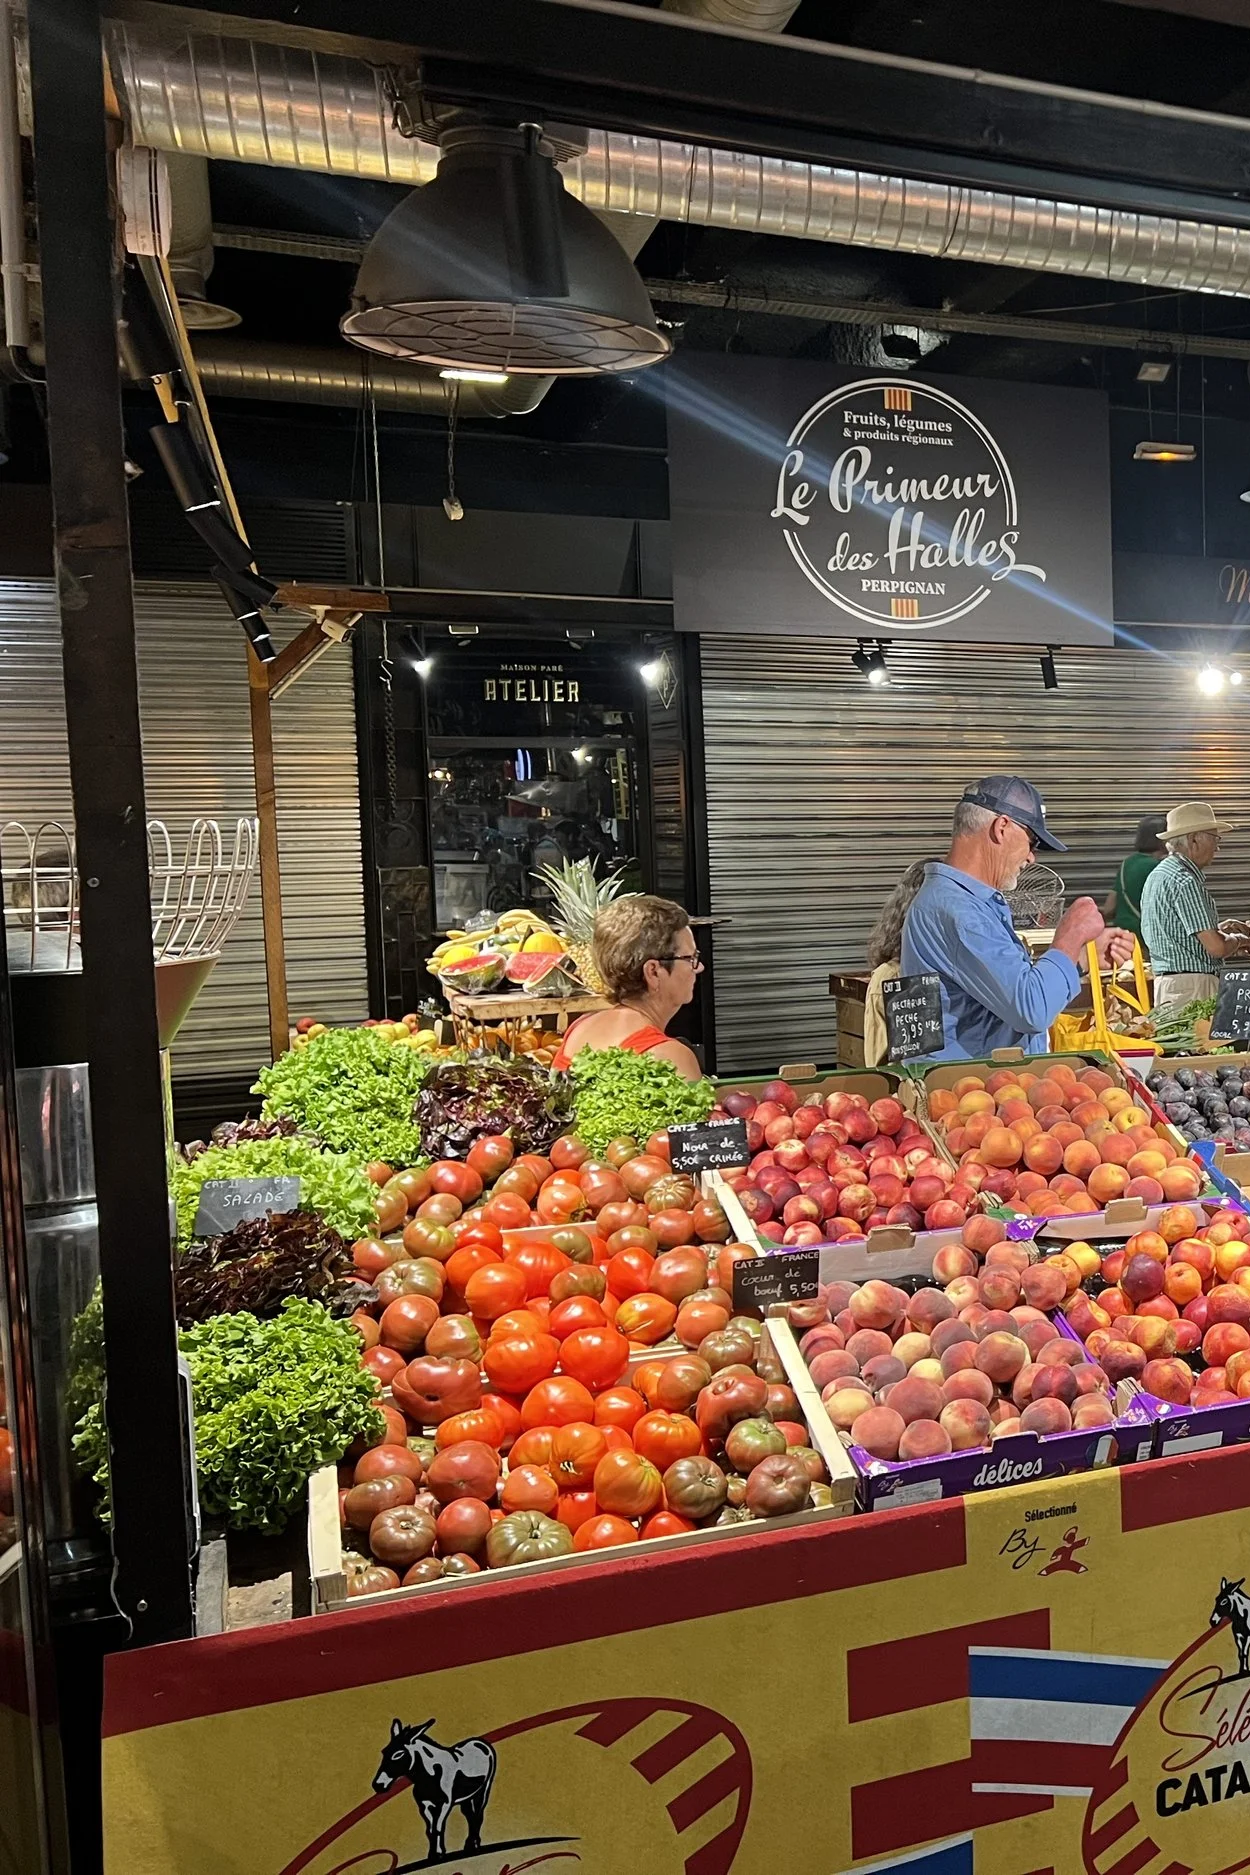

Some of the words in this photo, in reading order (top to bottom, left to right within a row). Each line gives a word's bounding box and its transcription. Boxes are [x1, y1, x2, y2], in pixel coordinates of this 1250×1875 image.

[843, 410, 891, 430] Fruits,
[894, 414, 953, 433] légumes
[842, 427, 852, 438] &
[854, 429, 900, 441] produits
[901, 432, 954, 446] régionaux
[770, 444, 818, 526] Le
[828, 445, 1000, 513] Primeur
[827, 532, 879, 573] des
[883, 507, 1046, 583] Halles
[860, 579, 946, 596] PERPIGNAN
[500, 664, 537, 672] MAISON
[484, 679, 580, 702] ATELIER
[895, 1012, 918, 1028] PECHE
[901, 1023, 923, 1044] 3,95
[720, 1137, 735, 1149] de
[203, 1180, 227, 1189] CAT
[273, 1177, 291, 1185] FR
[222, 1191, 285, 1207] SALADE
[734, 1260, 754, 1269] CAT
[781, 1251, 819, 1263] FRANCE
[784, 1268, 801, 1278] de
[973, 1457, 1043, 1486] délices
[1024, 1502, 1078, 1522] Sélectionné
[998, 1528, 1047, 1569] By
